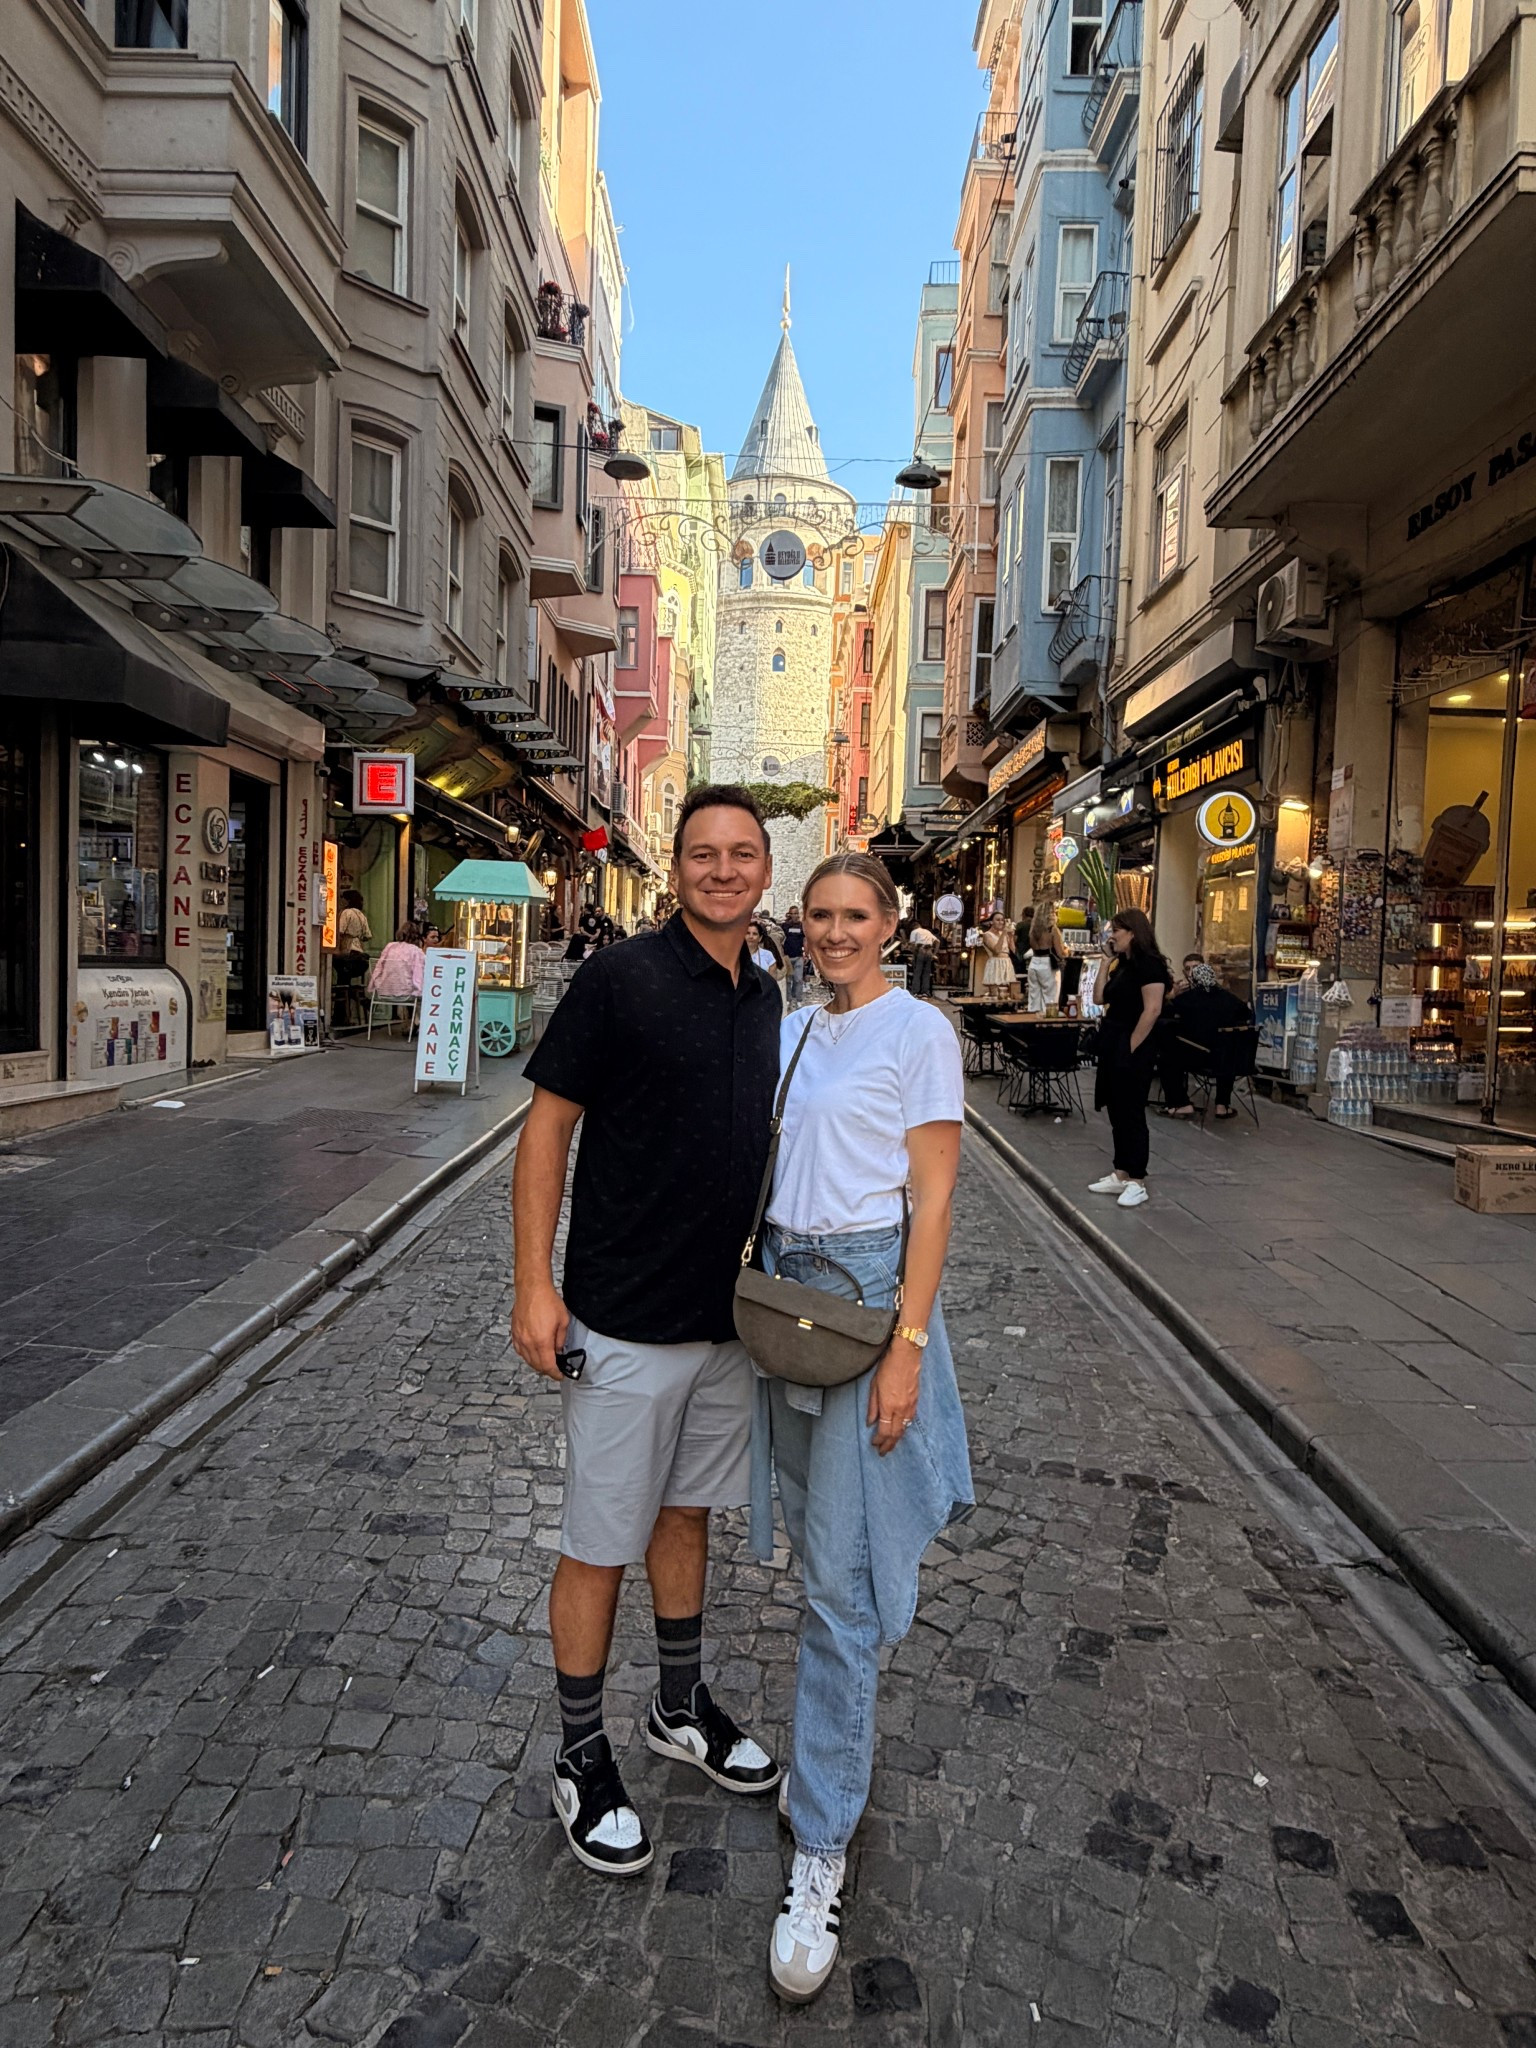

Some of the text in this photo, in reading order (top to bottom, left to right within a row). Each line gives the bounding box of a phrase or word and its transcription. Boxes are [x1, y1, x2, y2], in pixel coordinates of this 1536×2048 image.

[1407, 471, 1477, 541] ERSOY
[367, 764, 397, 801] E
[1167, 755, 1200, 801] KULEDİBİ
[1201, 739, 1243, 785] PİLAVCISI
[173, 773, 192, 947] ECZANE
[297, 847, 307, 902] ECZANE
[424, 966, 443, 1074] ECZANE
[448, 967, 466, 1076] PHARMACY
